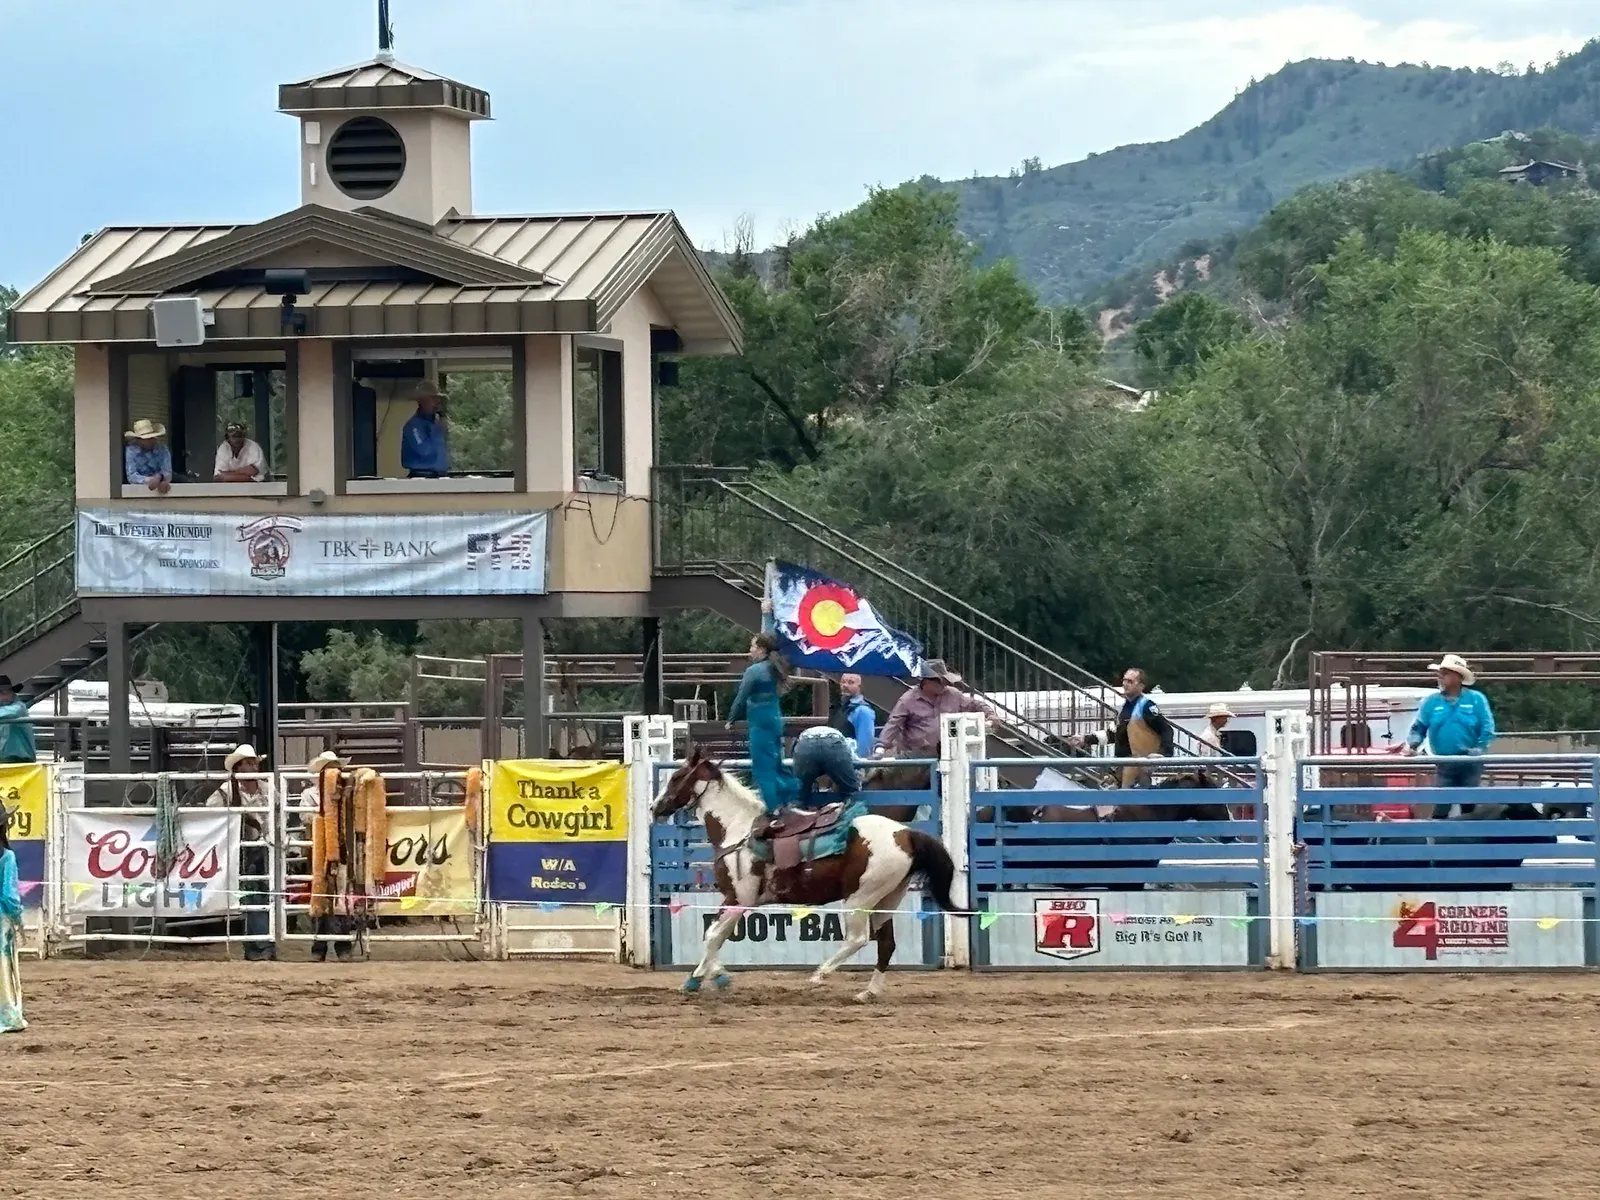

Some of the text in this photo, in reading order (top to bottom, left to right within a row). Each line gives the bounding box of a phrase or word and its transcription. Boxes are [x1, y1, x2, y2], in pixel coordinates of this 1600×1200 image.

[167, 523, 213, 539] ROUNDUP
[319, 540, 439, 558] TBK BANK
[517, 780, 601, 801] Thank a
[507, 803, 614, 837] Cowgirl
[541, 858, 577, 871] W/A
[1038, 914, 1095, 948] R
[1393, 902, 1508, 960] 4 CORNERS
[1438, 920, 1509, 933] ROOFING
[1115, 930, 1137, 944] Big
[1165, 930, 1189, 942] Got
